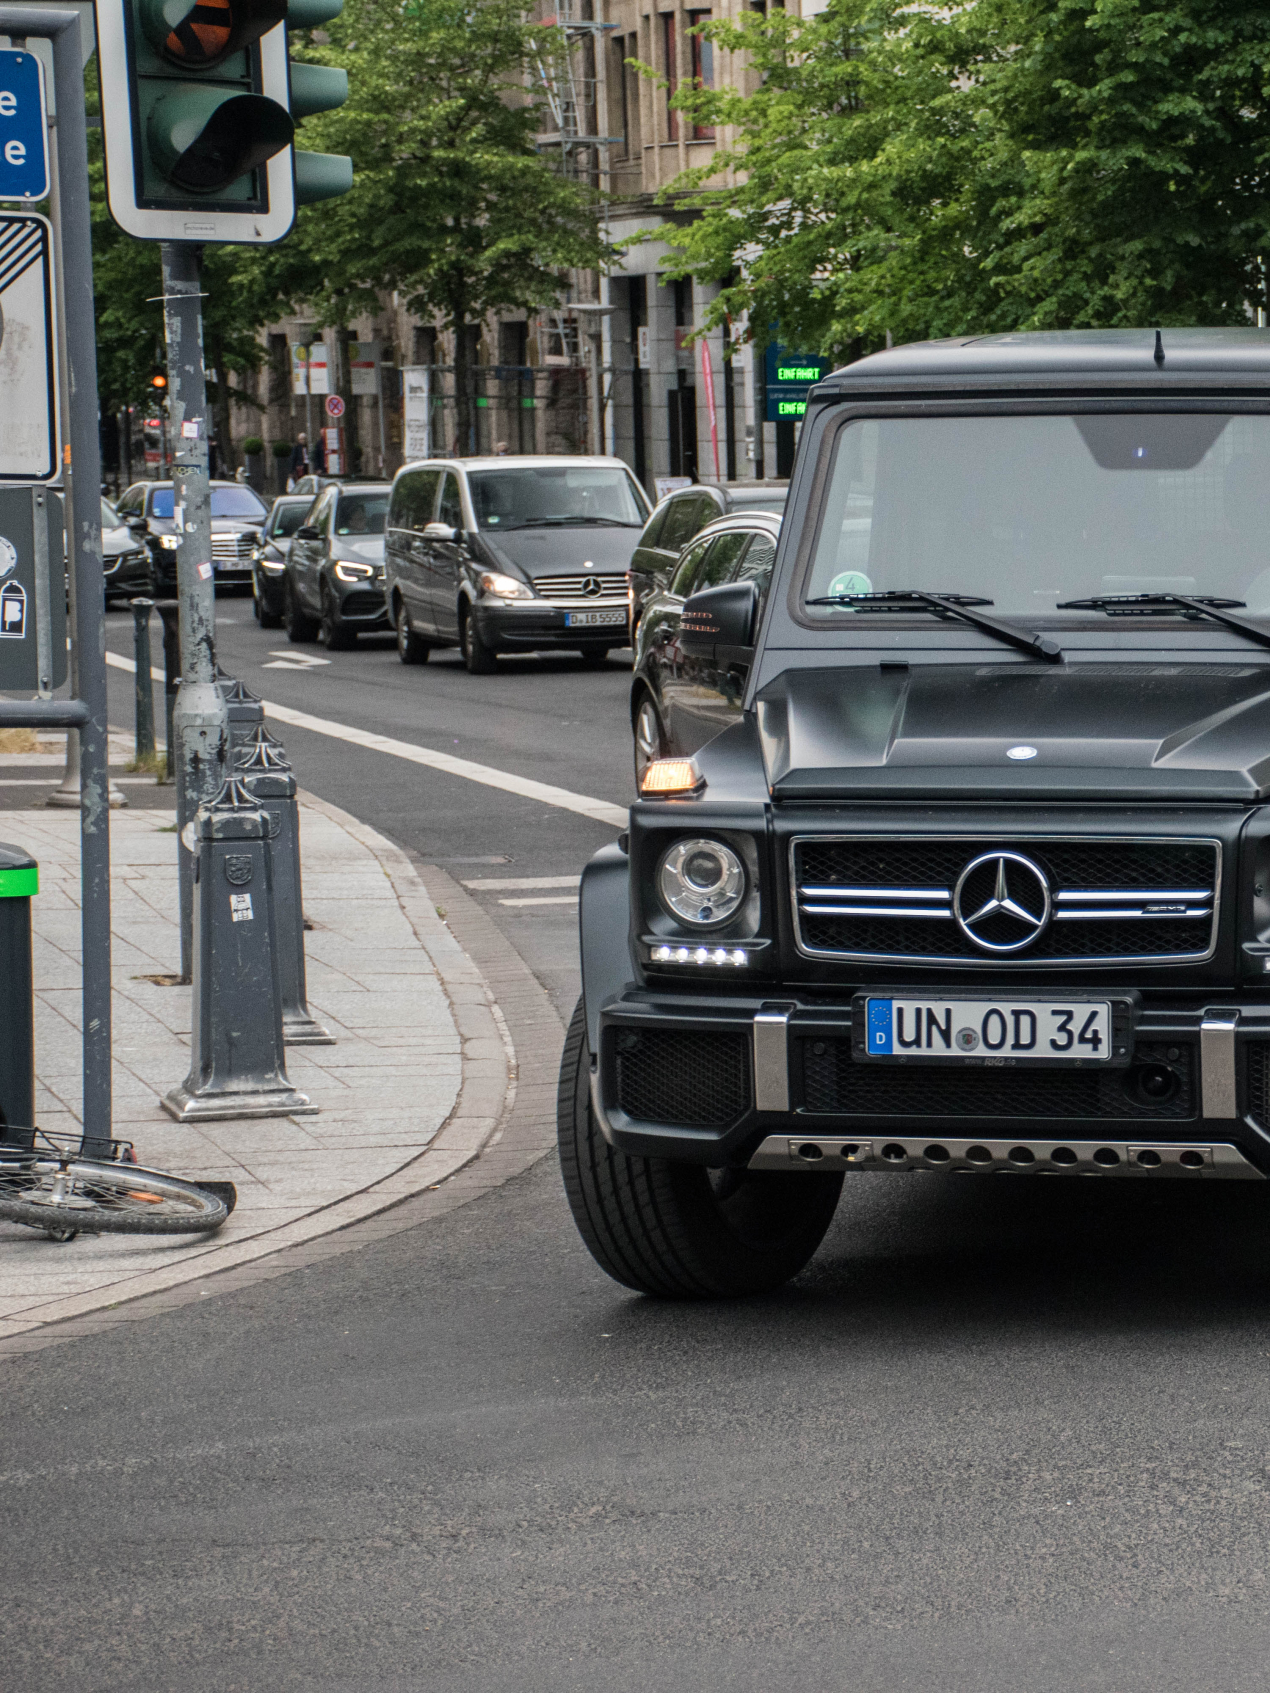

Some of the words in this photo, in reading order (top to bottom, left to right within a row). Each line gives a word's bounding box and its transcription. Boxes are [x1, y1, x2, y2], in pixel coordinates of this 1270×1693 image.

[777, 367, 820, 380] EINFAHRT
[571, 614, 578, 625] D
[896, 1006, 952, 1049] UN
[981, 1007, 1037, 1051] OD
[1049, 1008, 1103, 1052] 34
[875, 1032, 886, 1045] D
